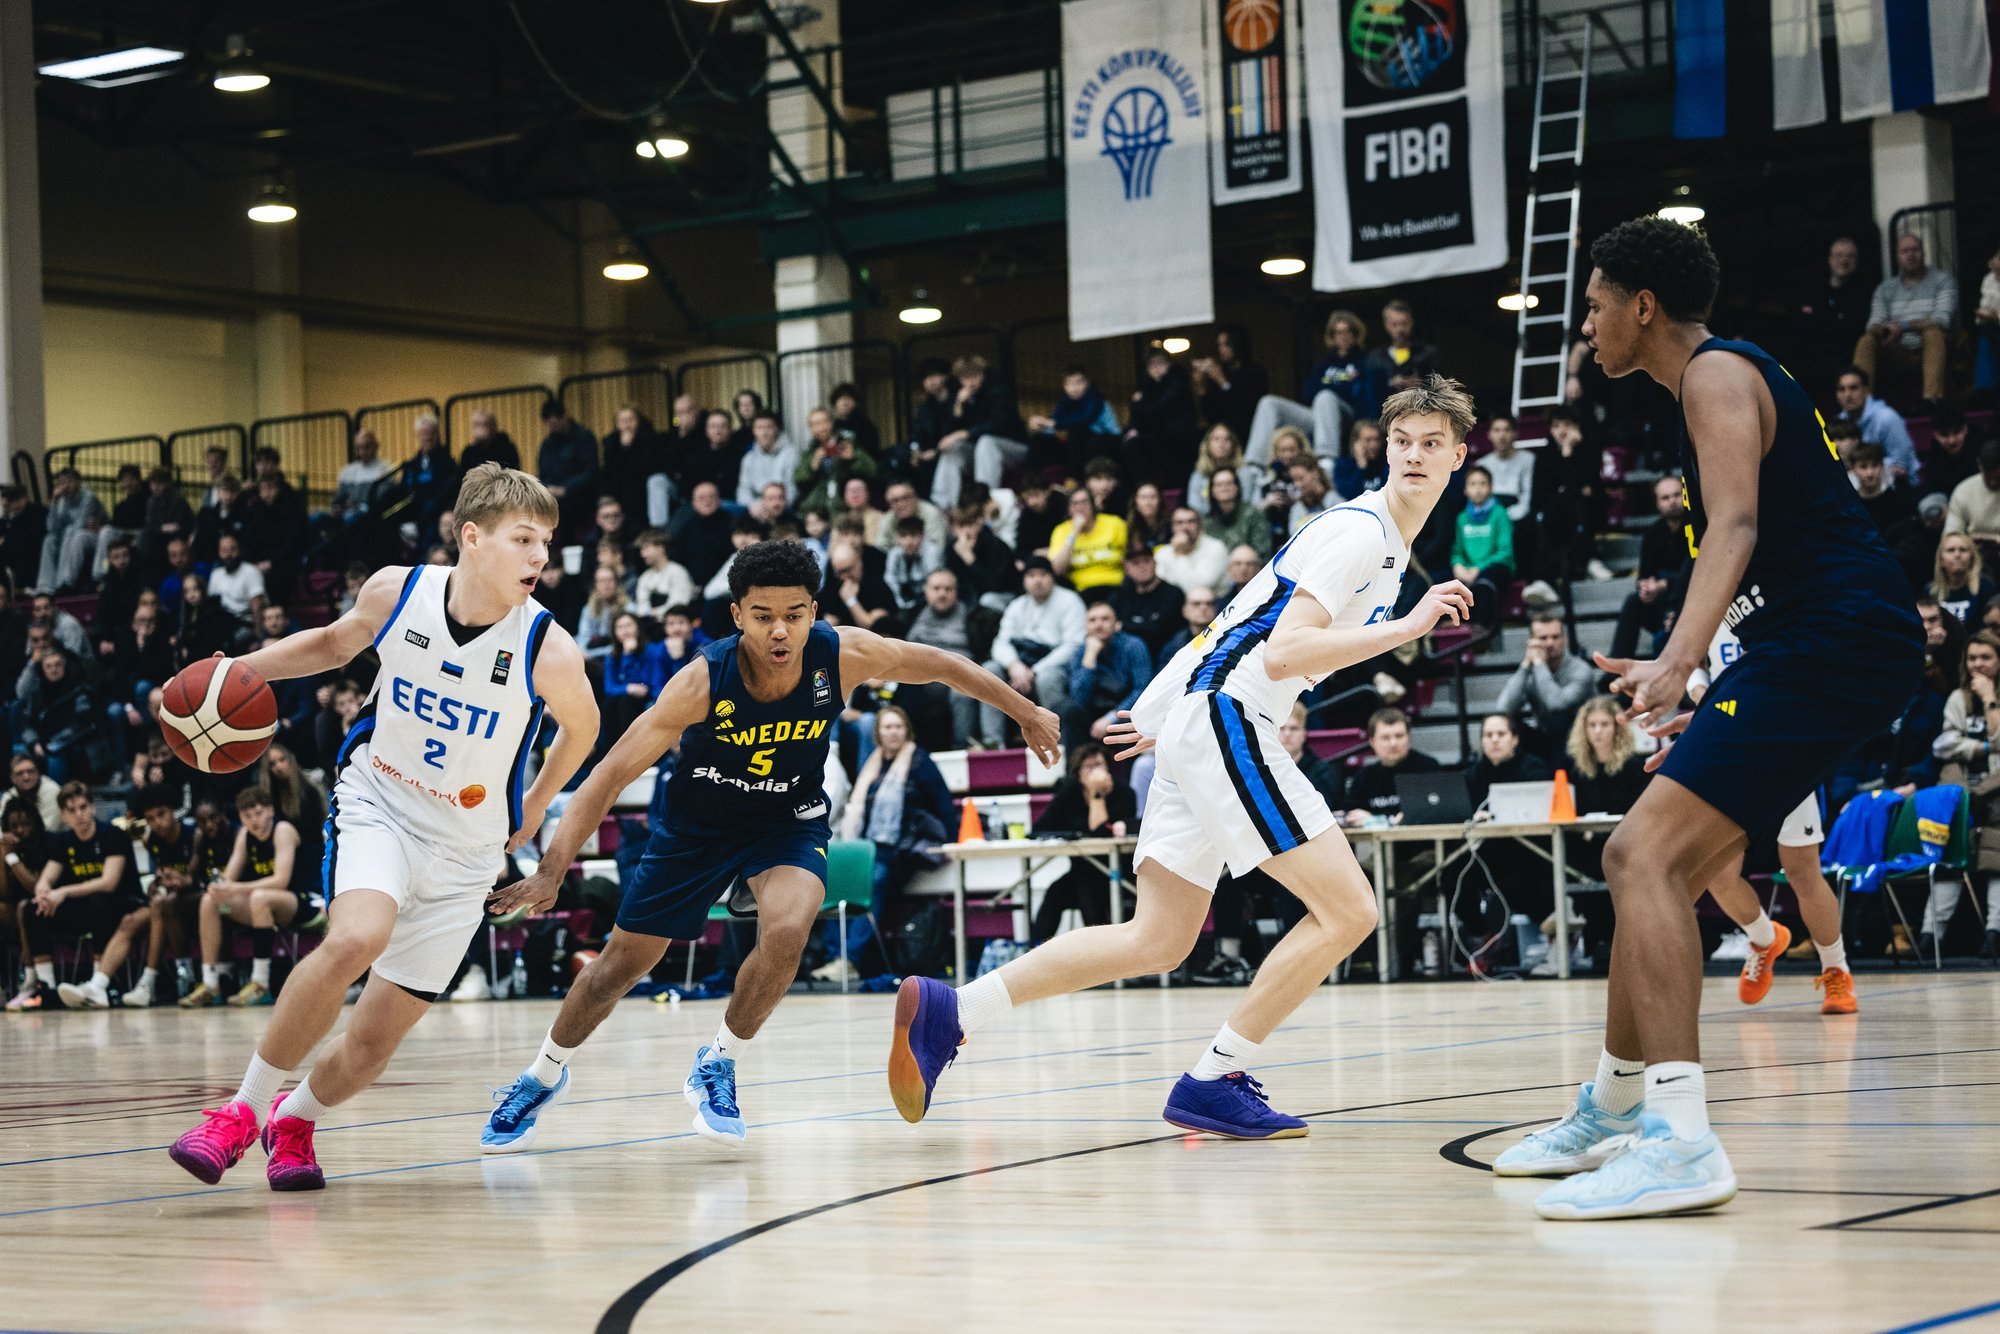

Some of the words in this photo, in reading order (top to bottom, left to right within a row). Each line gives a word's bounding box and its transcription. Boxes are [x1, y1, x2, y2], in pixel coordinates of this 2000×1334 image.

[1365, 122, 1450, 182] FIBA
[1361, 226, 1379, 240] We
[1403, 214, 1459, 237] Basketball
[406, 631, 429, 647] BALLZY
[393, 677, 500, 739] EESTI
[423, 738, 447, 770] 2
[747, 747, 777, 776] 5
